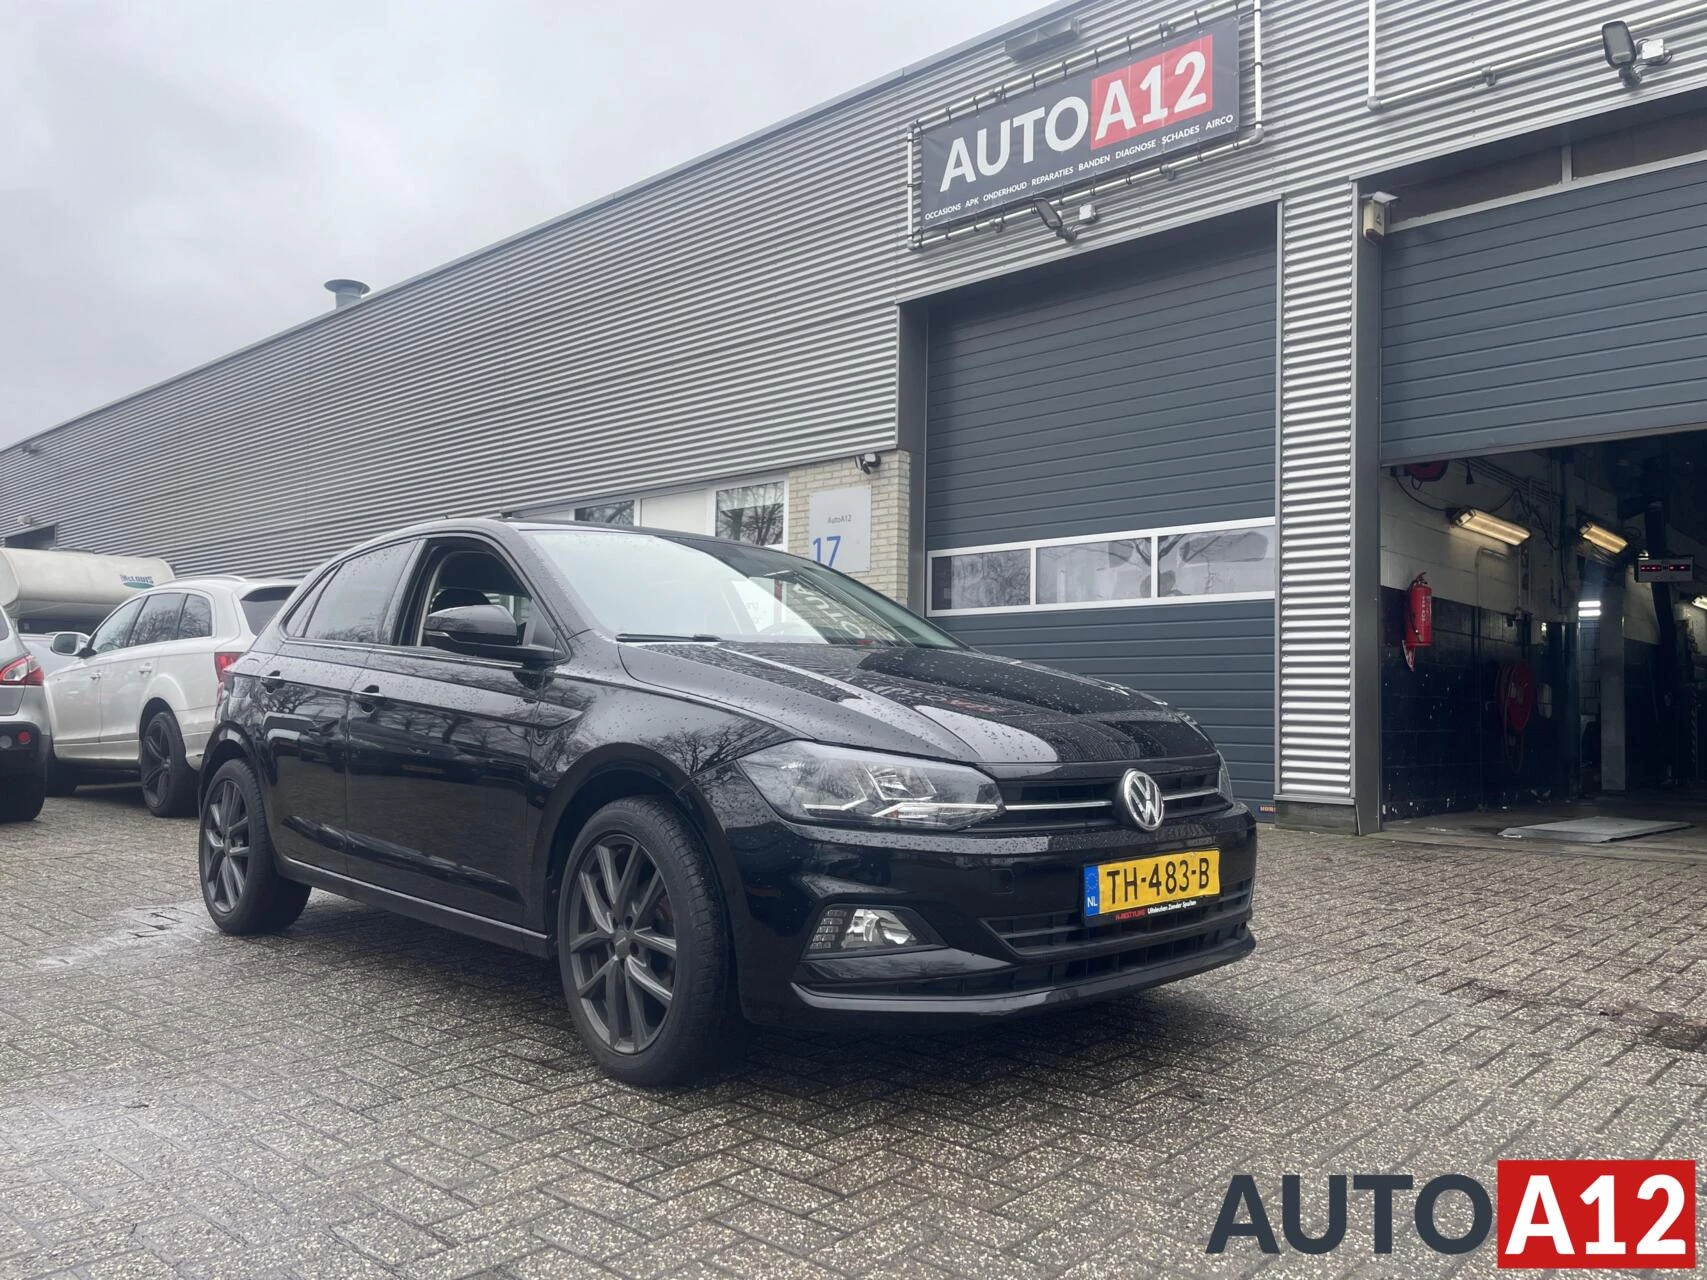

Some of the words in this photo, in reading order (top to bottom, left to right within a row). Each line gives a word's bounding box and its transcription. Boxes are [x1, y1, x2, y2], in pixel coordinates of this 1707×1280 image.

[924, 203, 962, 221] OCCASIONS
[964, 196, 980, 209] APK
[983, 181, 1028, 202] ONDERHOUD
[1031, 166, 1074, 186] REPARATIES
[1078, 154, 1111, 172] BANDEN
[1115, 139, 1157, 159] DIAGNOSE
[1161, 125, 1200, 145] SCHADES
[1205, 114, 1234, 131] AIRCO
[812, 535, 842, 569] 17
[1106, 857, 1210, 905] TH-483-B
[1087, 896, 1099, 908] NL
